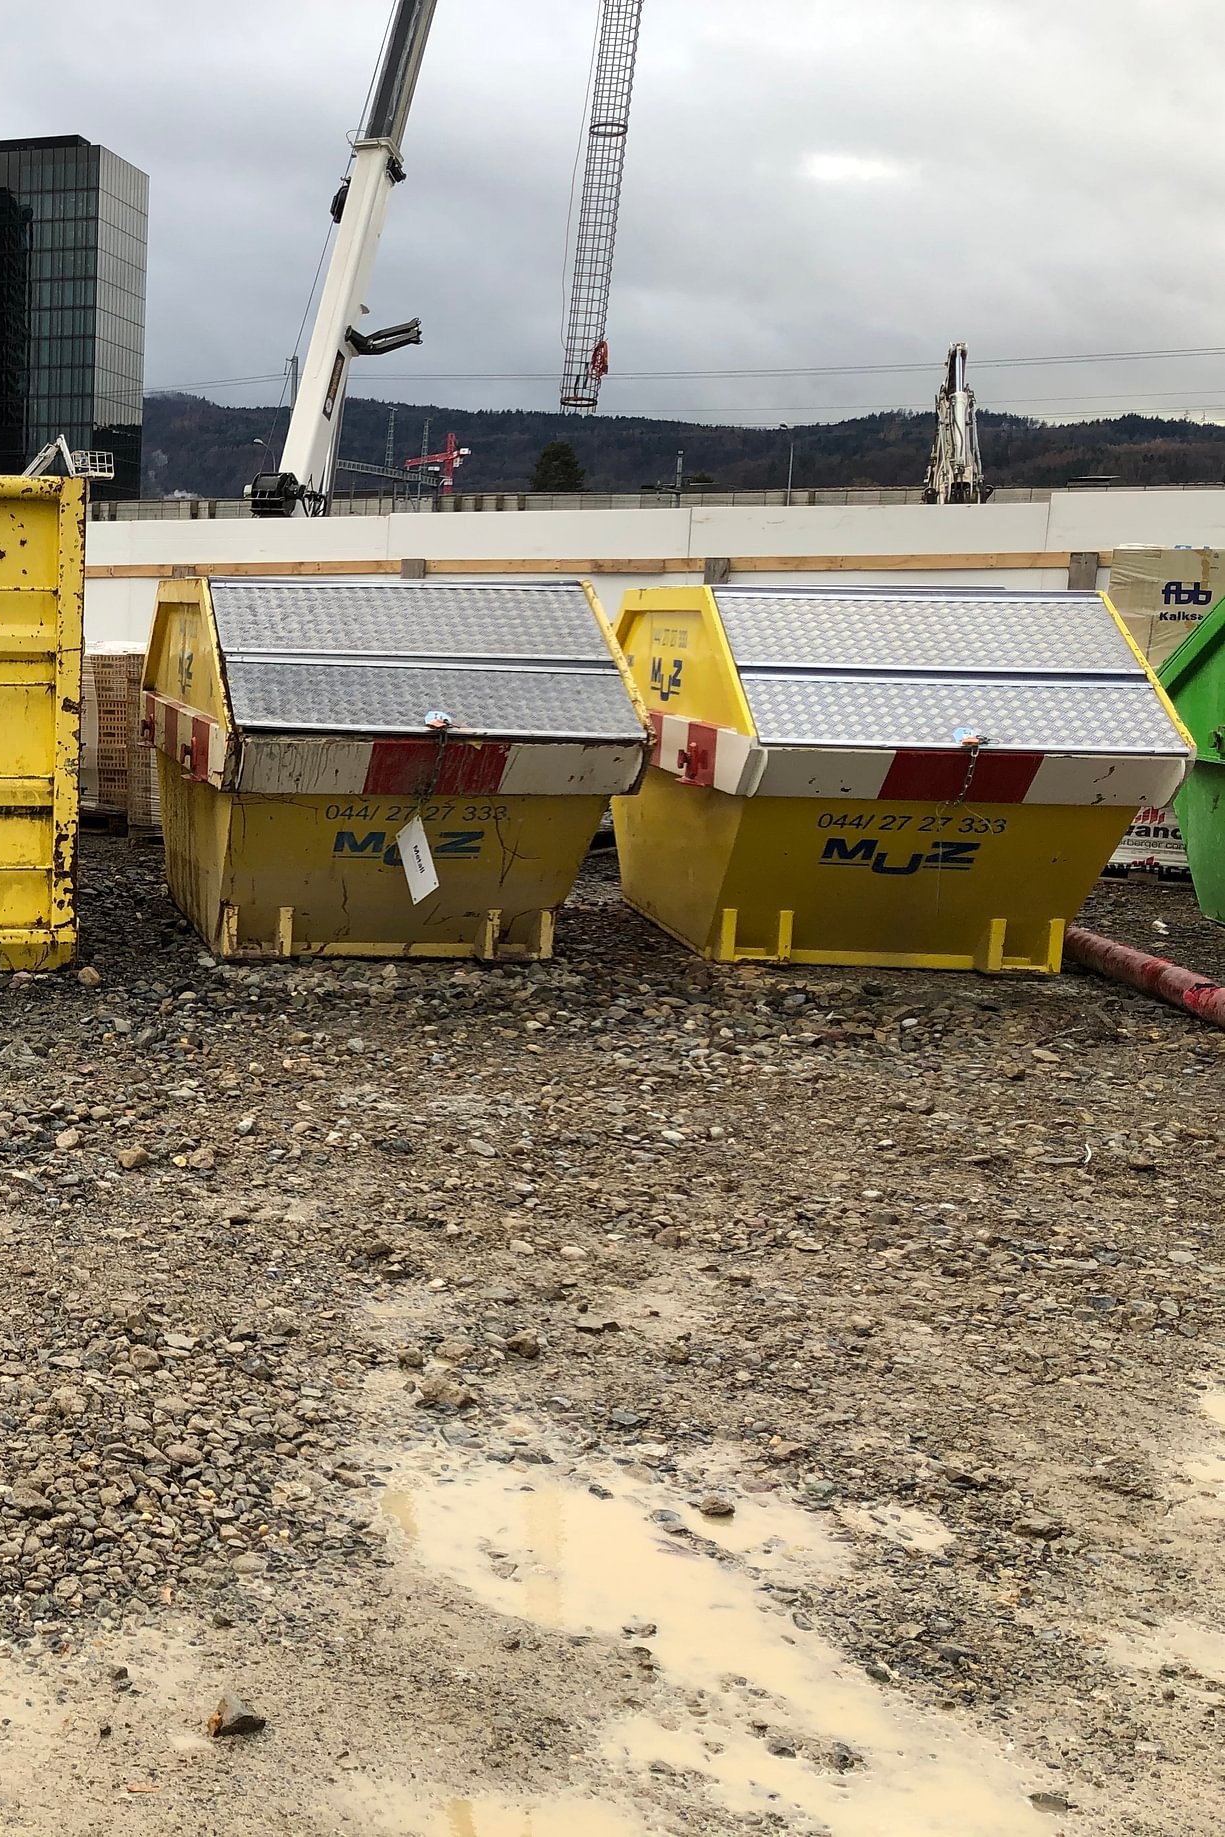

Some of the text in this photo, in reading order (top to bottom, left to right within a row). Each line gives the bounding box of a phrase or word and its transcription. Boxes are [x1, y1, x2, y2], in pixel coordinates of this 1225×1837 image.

[1161, 581, 1213, 606] fbb
[651, 656, 683, 702] MUZ
[324, 804, 380, 821] 044/
[385, 805, 418, 822] 27
[422, 805, 456, 822] 27
[817, 813, 1008, 834] 044/ 27 27 333
[412, 844, 426, 874] Metall
[818, 837, 982, 876] MUZ
